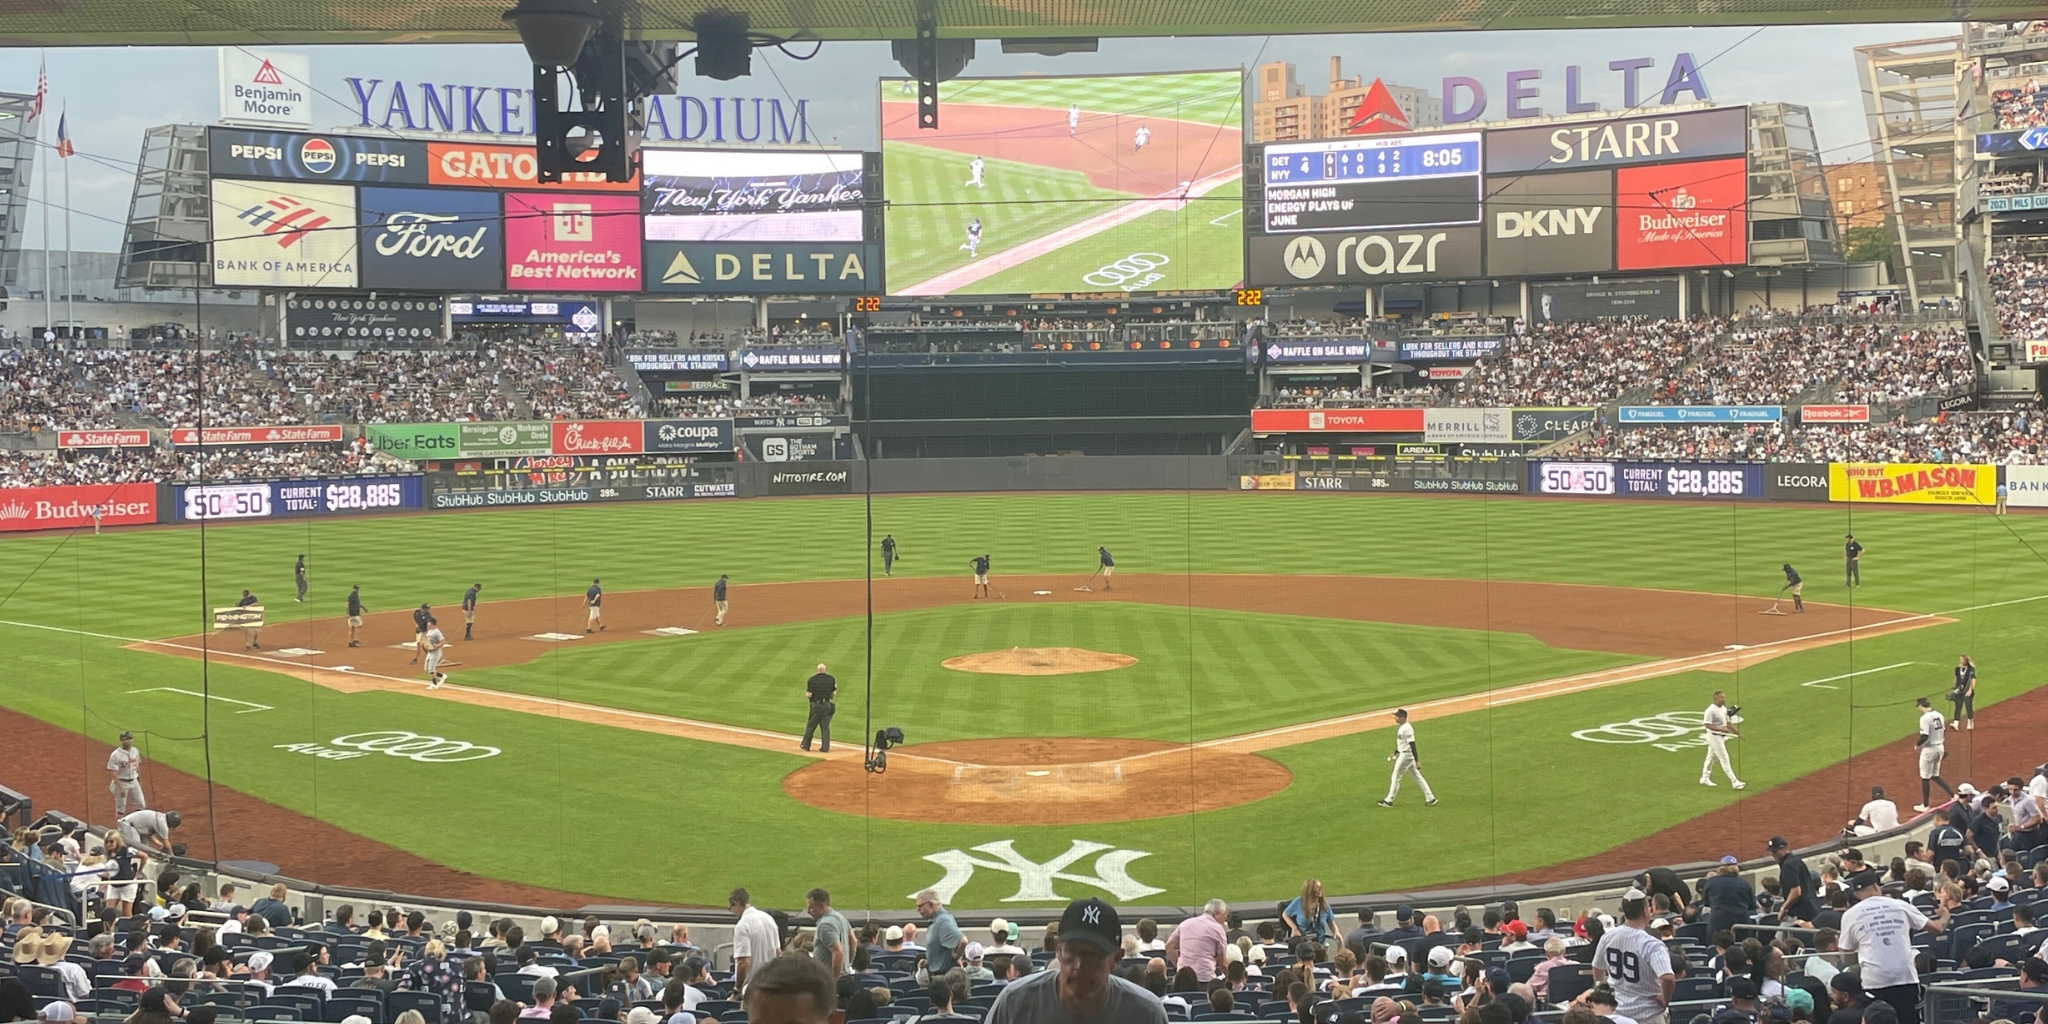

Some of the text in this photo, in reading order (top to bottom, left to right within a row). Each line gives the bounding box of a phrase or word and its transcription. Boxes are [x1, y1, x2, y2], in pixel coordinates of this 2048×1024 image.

[234, 85, 302, 102] Benjamin
[1442, 52, 1710, 123] DELTA
[244, 100, 291, 116] Moore
[640, 95, 810, 143] ADIUM
[1549, 119, 1680, 164] STARR
[231, 145, 282, 160] PEPSI
[303, 151, 334, 161] PEPSI
[1272, 149, 1462, 167] DET 6 6 0 4 2 8:05
[356, 152, 405, 167] PEPSI
[1271, 170, 1290, 181] NYY
[1356, 165, 1364, 175] 0
[1378, 164, 1386, 174] 3
[1393, 163, 1400, 173] 2
[1300, 161, 1309, 173] 4
[656, 187, 712, 207] New
[715, 187, 769, 213] York
[1268, 187, 1336, 200] MORGAN HIGH
[1268, 201, 1306, 213] ENERGY
[1308, 200, 1340, 212] PLAYS
[2014, 199, 2029, 208] MLS
[1270, 215, 1298, 226] JUNE
[1496, 206, 1602, 239] DKNY
[1639, 212, 1726, 231] Budweiser
[375, 212, 488, 259] Ford
[1637, 228, 1724, 243] Made of America
[525, 249, 622, 265] America's
[1336, 232, 1447, 275] razr
[217, 260, 353, 274] BANK OF AMERICA
[510, 264, 638, 280] Best Network
[715, 252, 865, 281] DELTA
[1237, 290, 1261, 306] 2:22
[1283, 346, 1311, 357] RAFFLE
[1312, 346, 1323, 356] ON
[1324, 345, 1344, 356] SALE
[1345, 344, 1365, 355] NOW
[1402, 342, 1418, 351] LOOK
[1420, 341, 1432, 350] FOR
[1434, 341, 1461, 350] SELLERS
[1462, 340, 1476, 349] AND
[644, 353, 726, 363] FOR SELLERS AND KIOSKS
[759, 354, 840, 365] RAFFLE ON SALE NOW
[1410, 350, 1450, 359] THROUGHOUT
[1452, 349, 1464, 358] THE
[634, 361, 718, 370] THROUGHOUT THE STADIUM
[1431, 369, 1463, 377] TOYOTA
[691, 381, 728, 389] TERRACE
[1940, 395, 1973, 410] LEGORA
[1637, 410, 1769, 418] FANDUEL FANDUEL FANDUEL
[1803, 409, 1842, 418] Reebok
[1328, 416, 1365, 425] TOYOTA
[1427, 422, 1479, 431] MERRILL
[462, 424, 549, 435] Morningside Workmen's
[531, 431, 549, 440] Circle
[677, 426, 719, 440] coupa
[414, 434, 456, 449] Eats
[766, 445, 784, 456] GS
[773, 471, 847, 484] NITTOTIRE.COM
[1623, 468, 1664, 481] CURRENT
[1845, 467, 1885, 477] WHO BUT
[694, 484, 735, 492] CUTWATER
[1305, 477, 1343, 489] STARR
[1414, 480, 1519, 491] StubHub StubHub StubHub
[1628, 480, 1658, 492] TOTAL:
[1667, 467, 1743, 497] $28,885
[1777, 475, 1828, 488] LEGORA
[2009, 481, 2048, 491] BANK
[280, 486, 322, 500] CURRENT
[326, 483, 400, 511] $28,885
[437, 489, 588, 508] StubHub StubHub StubHub
[646, 486, 684, 498] STARR
[35, 499, 150, 519] Budweiser
[285, 499, 318, 511] TOTAL:
[216, 613, 262, 621] PENNINGTON
[1606, 947, 1640, 983] 99
